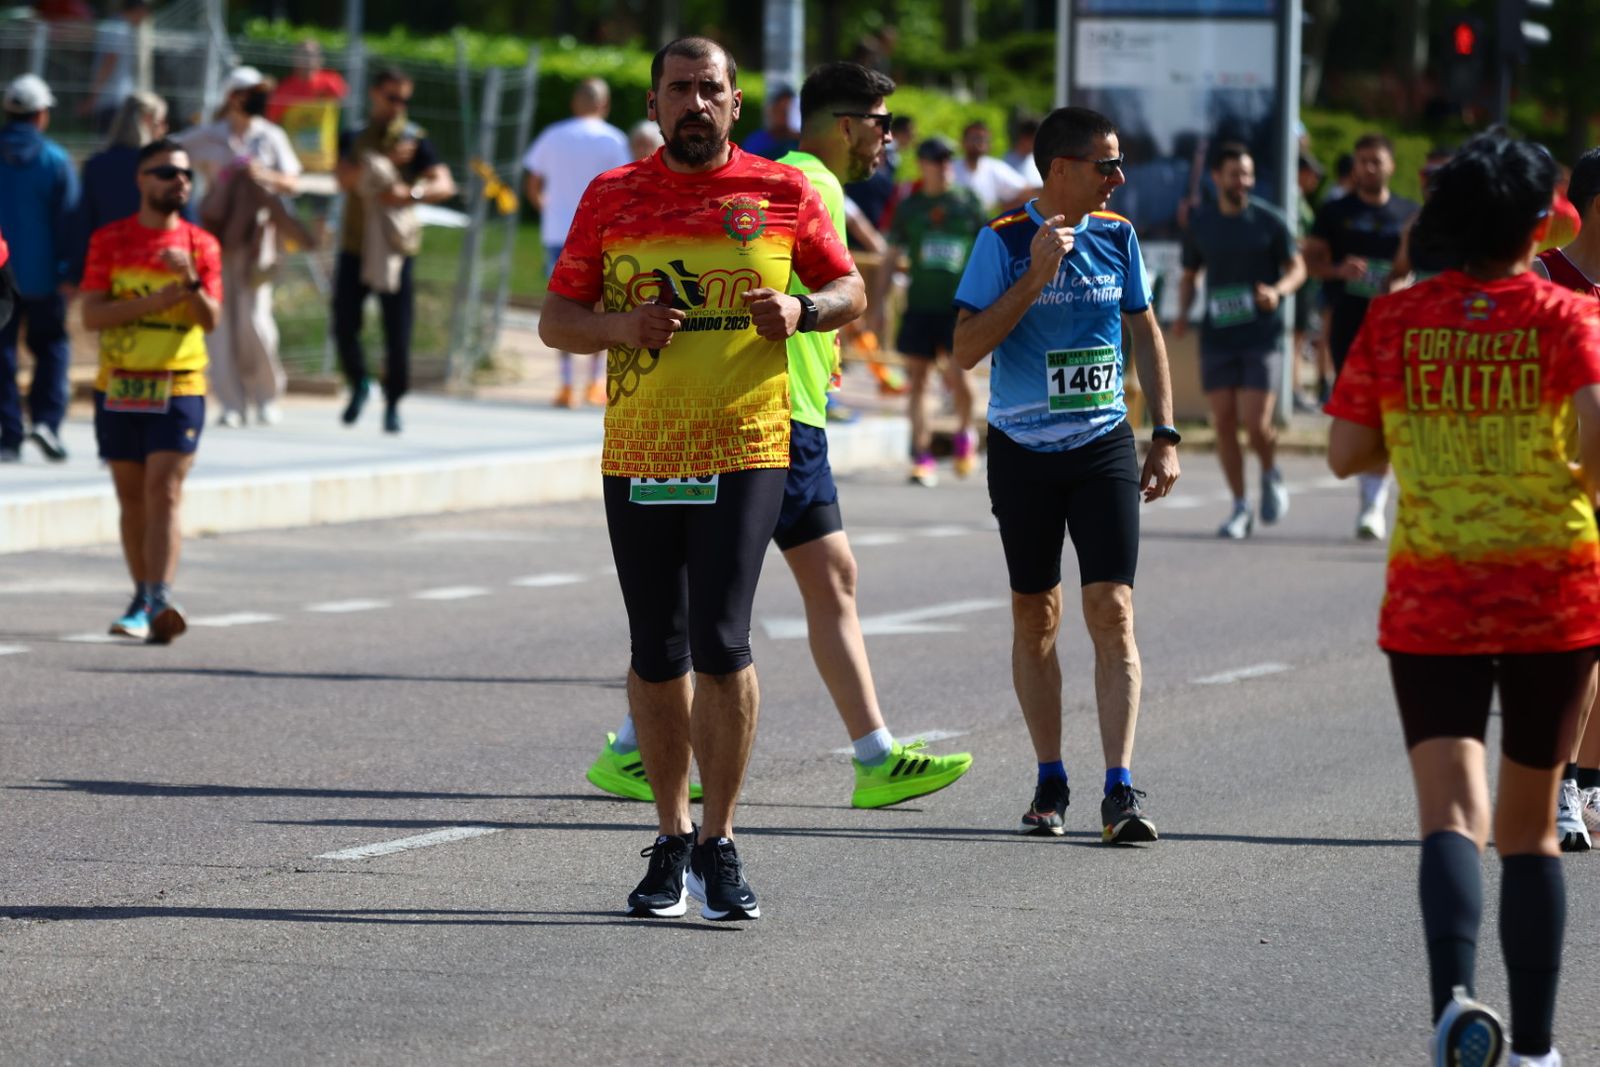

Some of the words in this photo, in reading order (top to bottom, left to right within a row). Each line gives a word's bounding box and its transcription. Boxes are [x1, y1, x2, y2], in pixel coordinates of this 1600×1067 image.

[1403, 328, 1540, 360] FORTALEZA
[1052, 365, 1115, 395] 1467
[1405, 364, 1540, 411] LEALTAD
